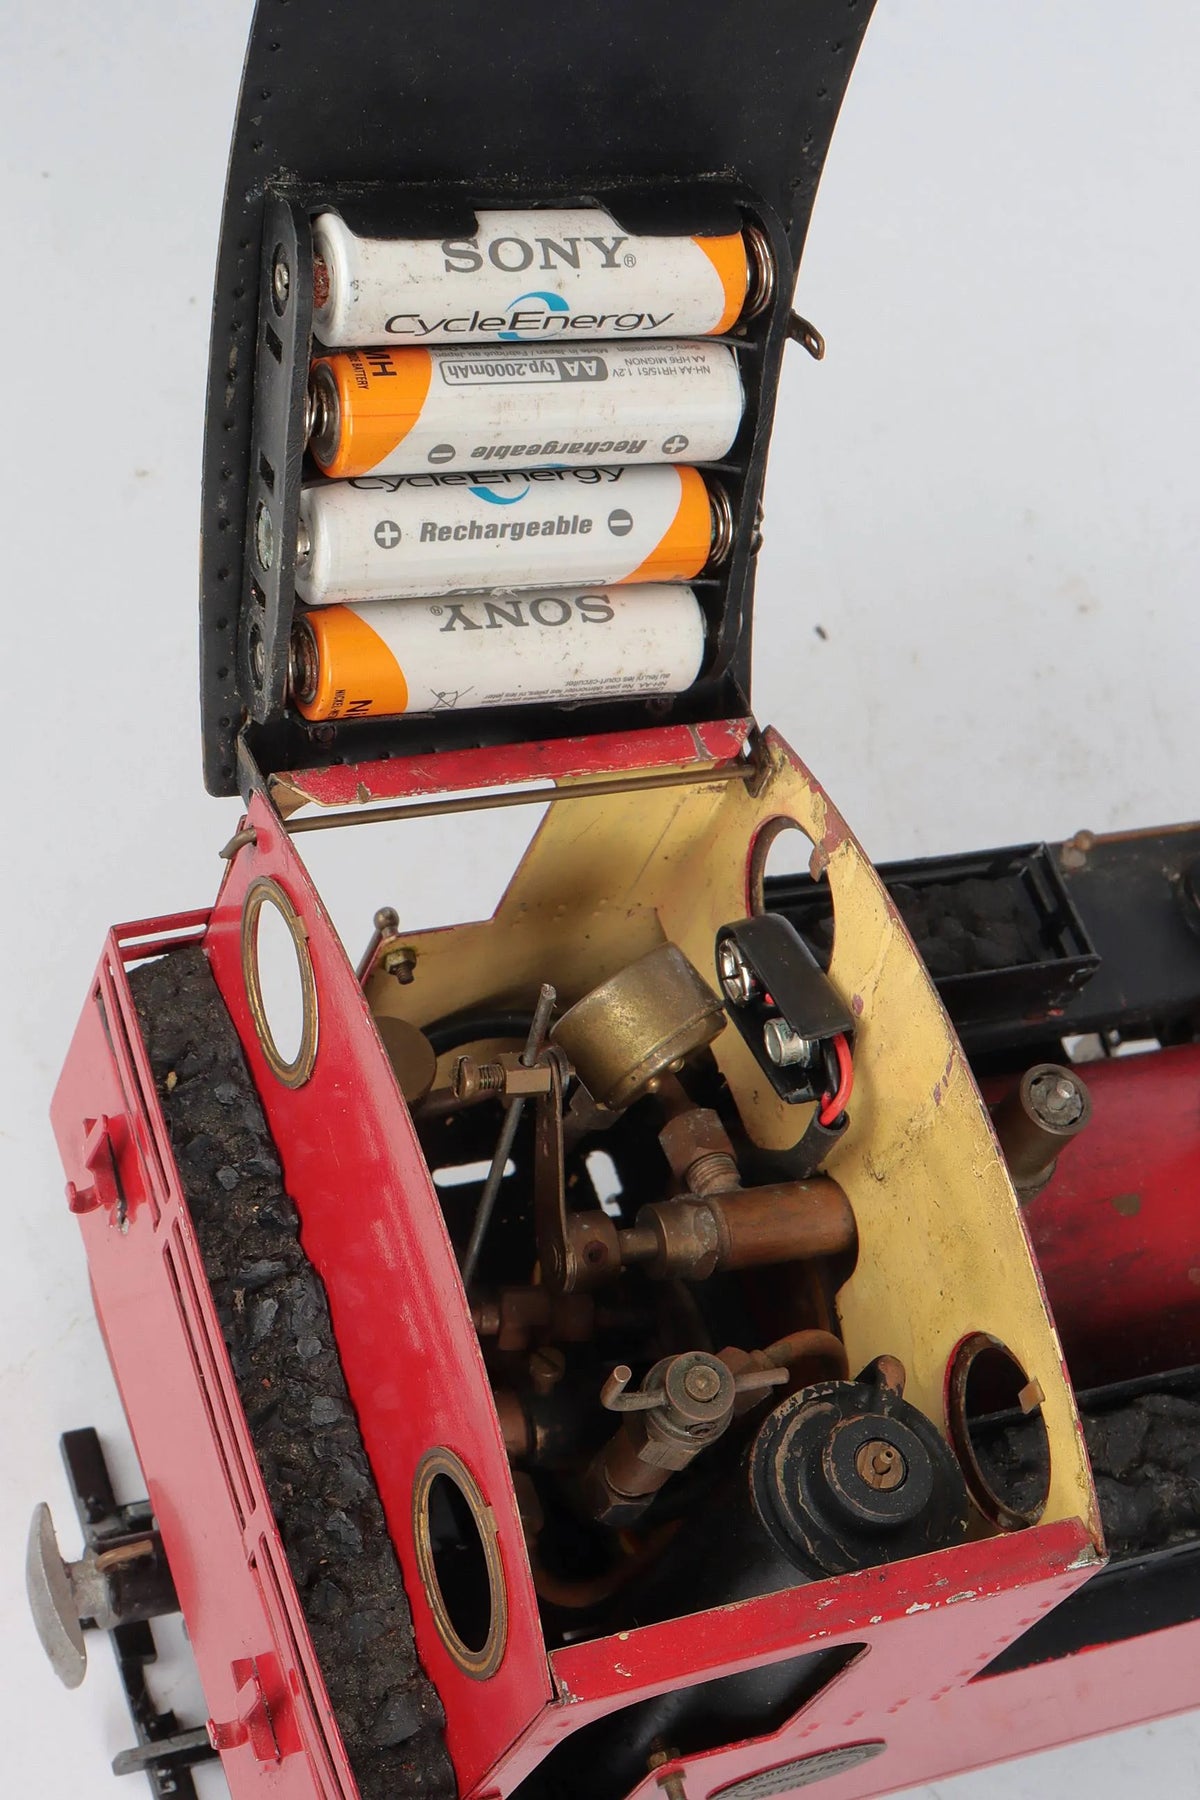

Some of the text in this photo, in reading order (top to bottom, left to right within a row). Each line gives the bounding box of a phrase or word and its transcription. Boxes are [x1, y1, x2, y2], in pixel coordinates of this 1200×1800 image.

[384, 310, 675, 337] CycleEnergy
[447, 359, 598, 379] AA typ.2000mAh
[612, 365, 711, 378] NH-AA HR15/51 1.2V
[625, 357, 668, 367] MIGNON
[351, 363, 370, 390] BATTERY
[470, 439, 649, 461] Rechargeable
[419, 514, 593, 542] Rechargeable
